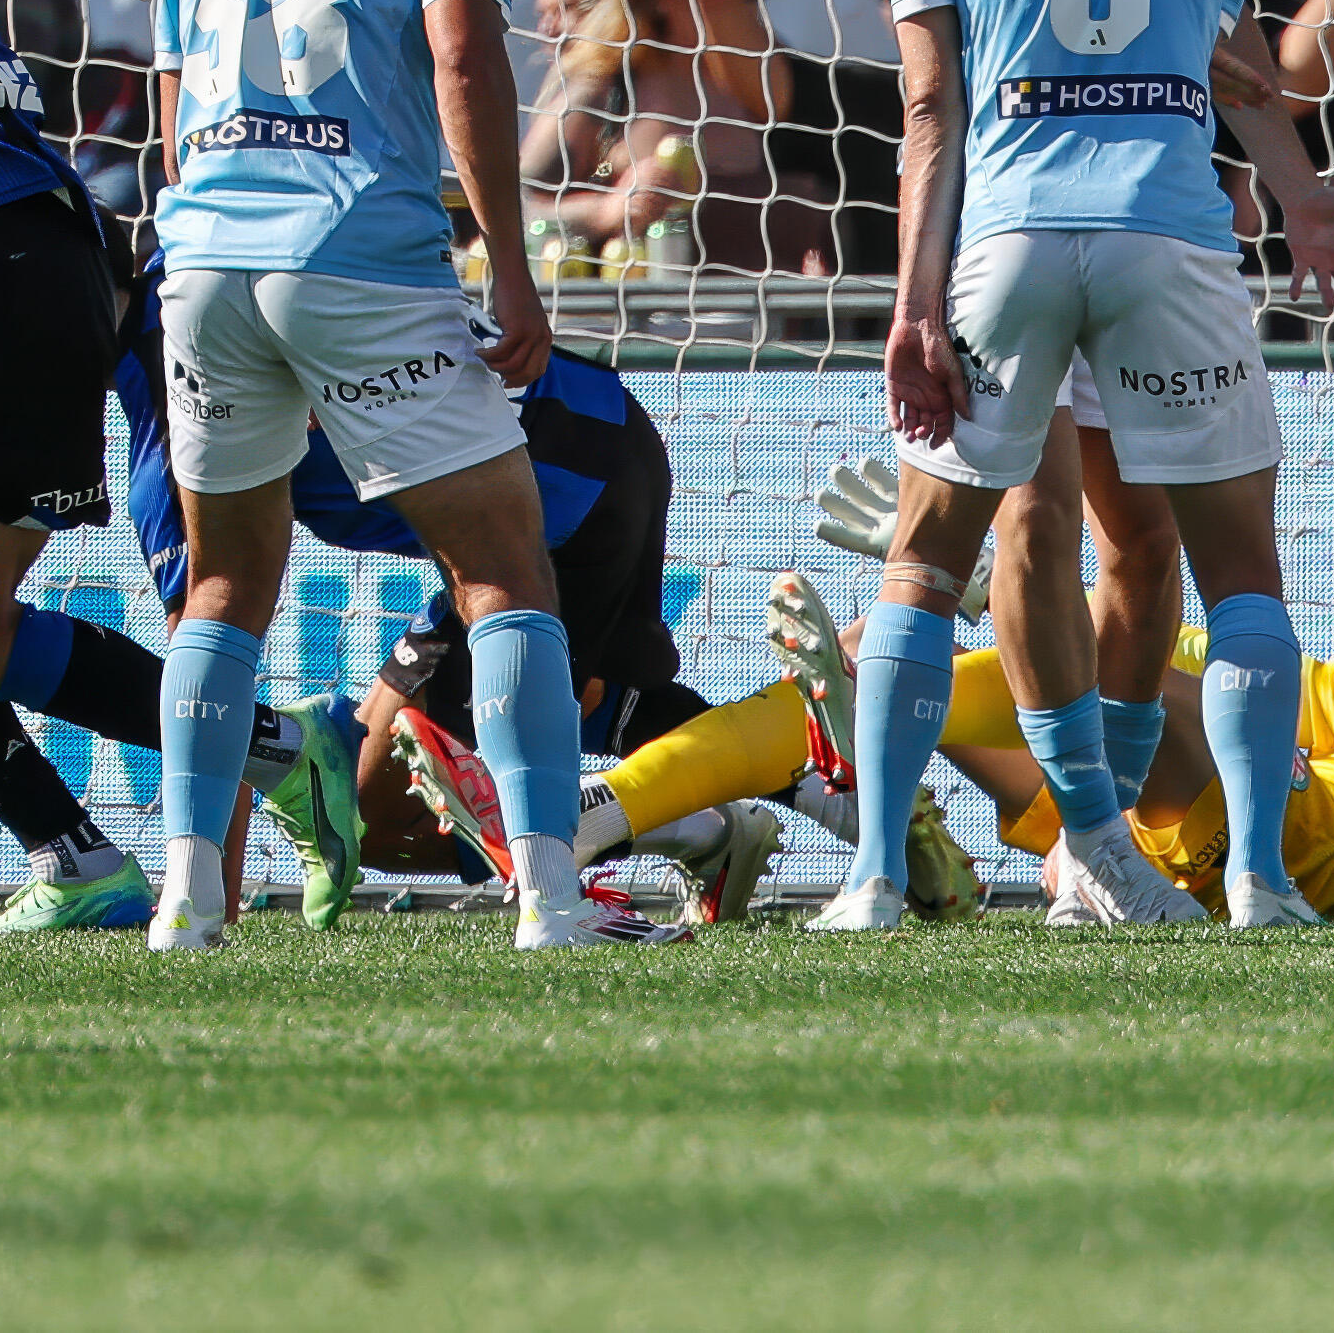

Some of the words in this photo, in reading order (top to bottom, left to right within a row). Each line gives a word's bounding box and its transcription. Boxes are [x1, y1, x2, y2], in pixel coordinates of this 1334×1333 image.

[1059, 82, 1205, 118] HOSTPLUS
[1120, 359, 1248, 396] NOSTRA
[1219, 666, 1275, 693] CITY
[174, 698, 229, 722] CITY
[477, 694, 509, 724] ITY
